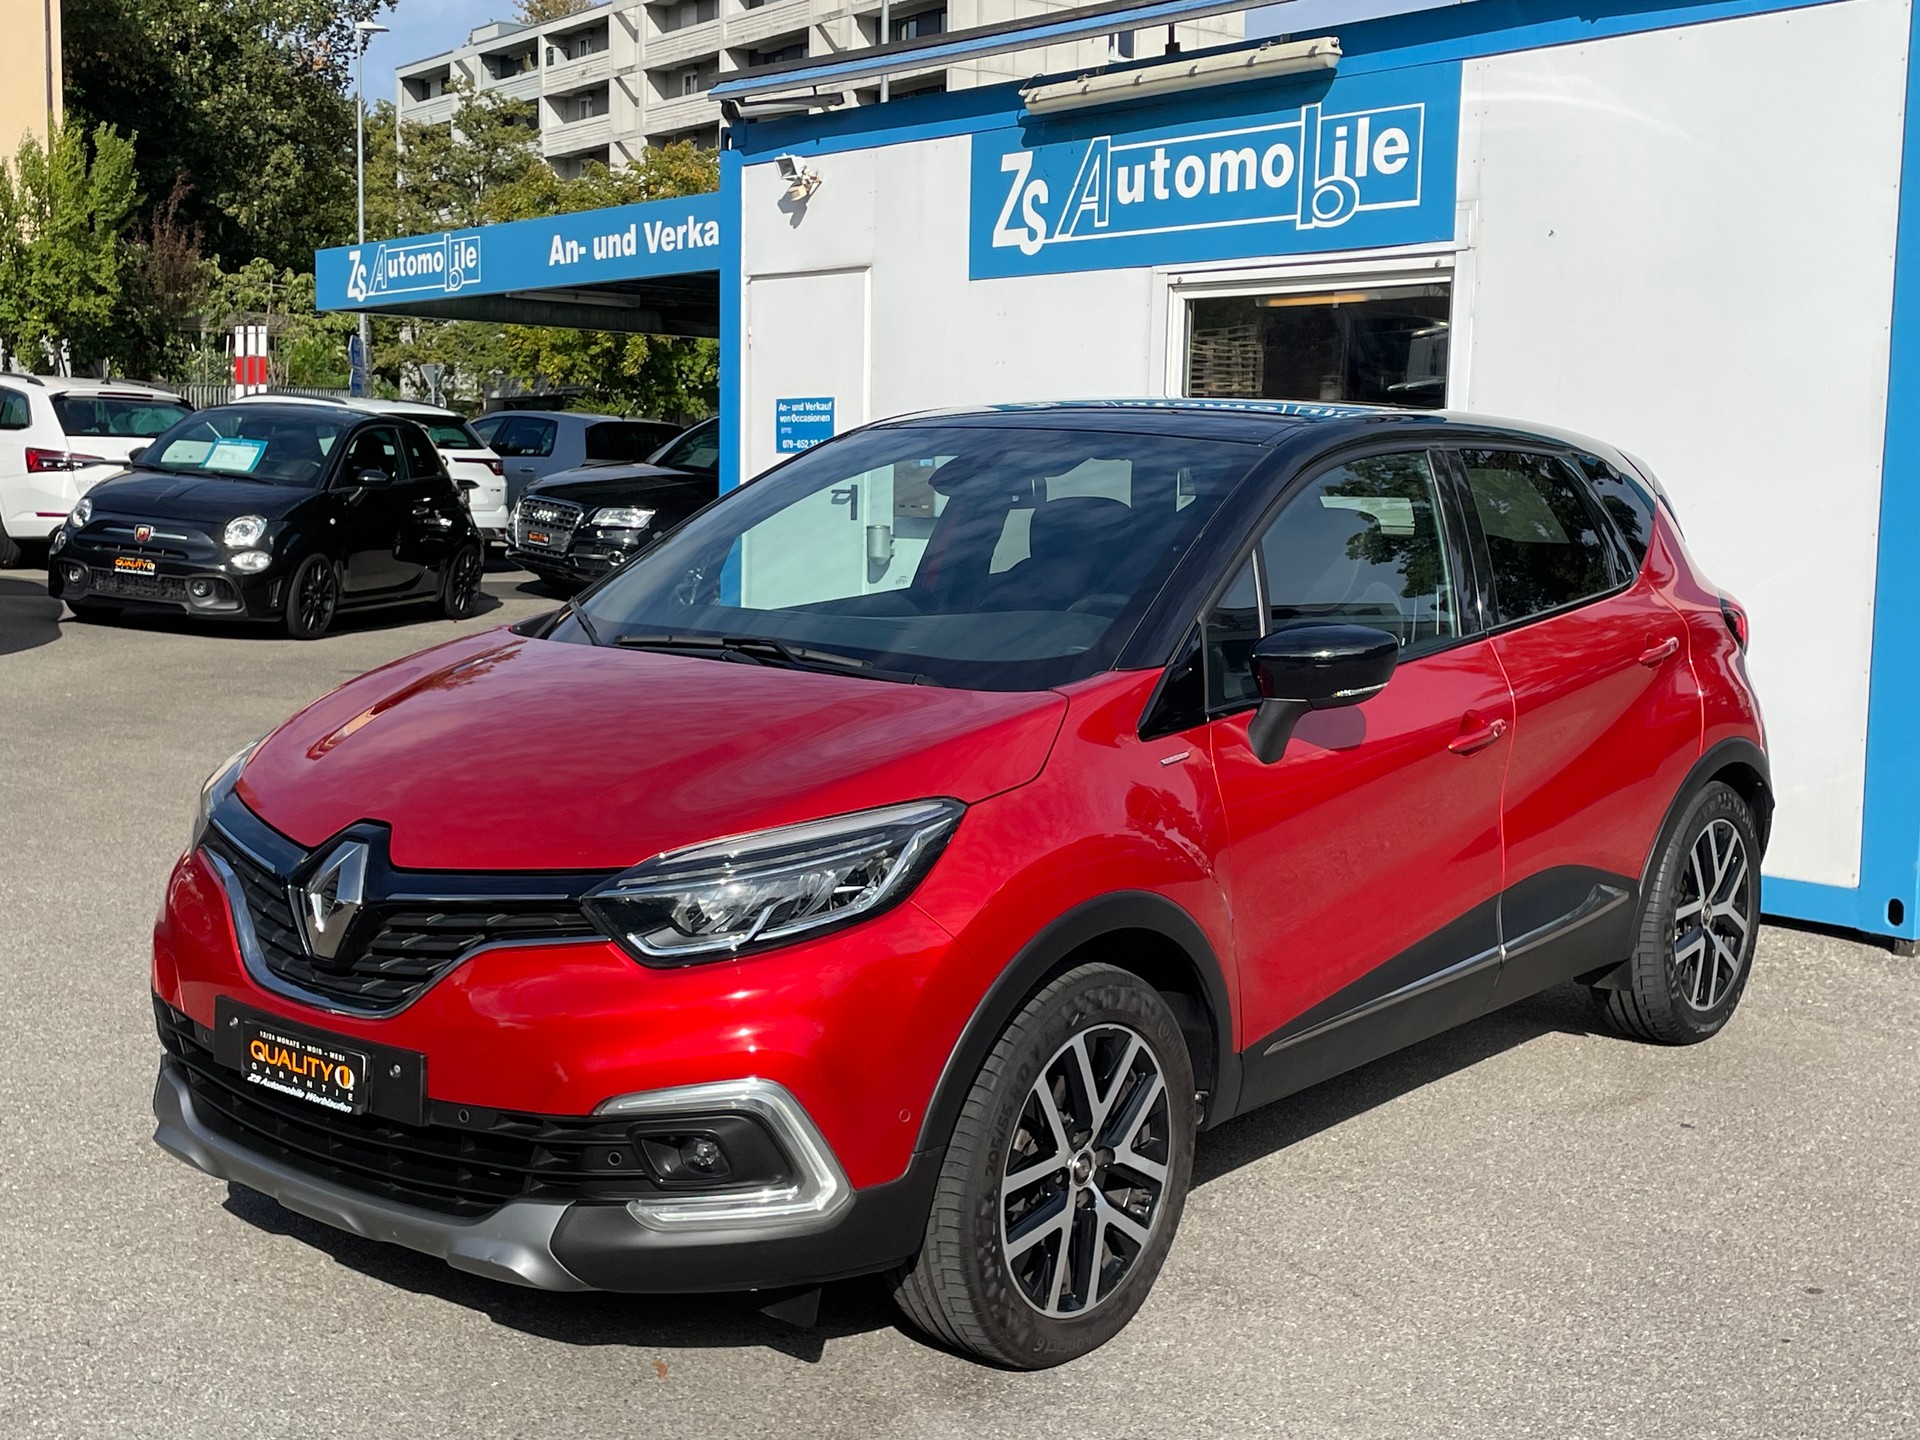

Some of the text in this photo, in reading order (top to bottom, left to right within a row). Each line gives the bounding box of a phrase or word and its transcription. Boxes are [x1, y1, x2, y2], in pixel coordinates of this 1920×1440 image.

[1054, 102, 1411, 240] Automobile
[548, 215, 720, 267] An- und Verka
[368, 233, 478, 295] Automobile
[792, 402, 804, 411] und
[805, 401, 832, 411] Verkauf
[792, 413, 831, 422] Occasionen
[250, 1040, 334, 1082] QUALITY
[260, 1076, 305, 1099] Automobile
[305, 1091, 353, 1113] Worblaufen
